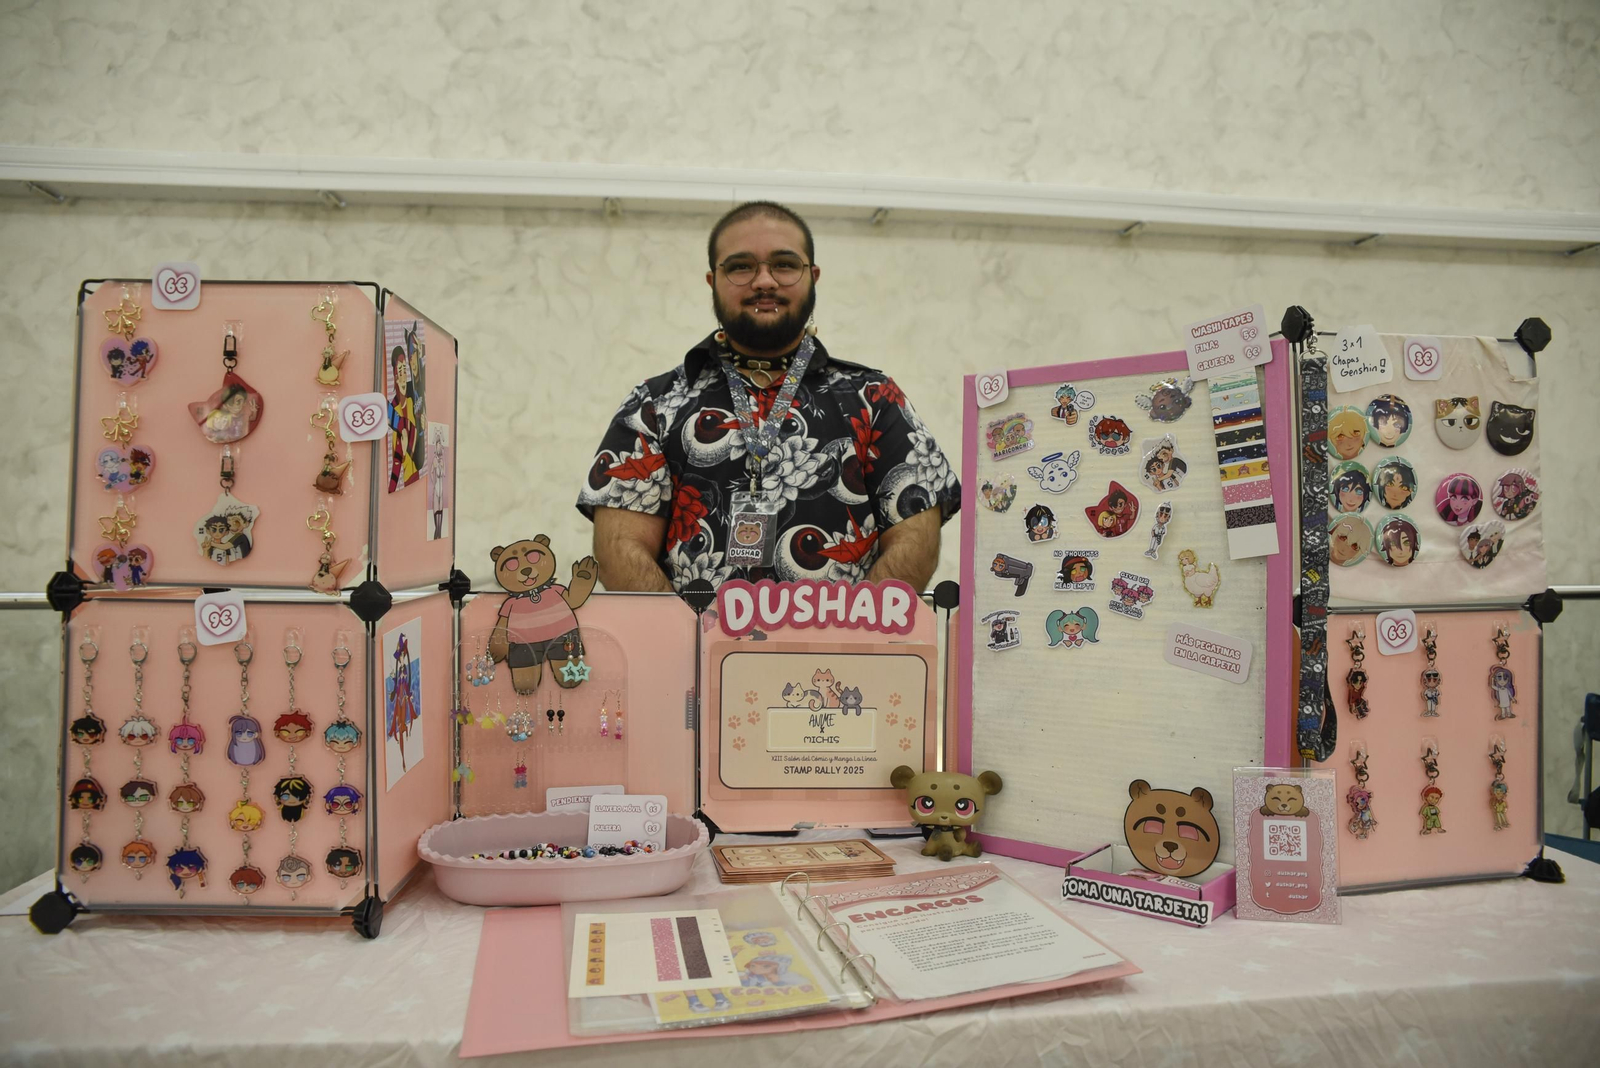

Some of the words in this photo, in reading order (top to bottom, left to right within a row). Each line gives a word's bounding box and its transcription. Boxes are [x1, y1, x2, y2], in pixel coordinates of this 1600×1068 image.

[165, 277, 188, 294] 6€
[1191, 321, 1222, 338] WASHI
[1222, 312, 1254, 330] TAPES
[1194, 340, 1219, 354] FINA:
[1242, 328, 1257, 340] 5€
[1197, 354, 1235, 371] GRUESA:
[1246, 346, 1260, 359] 6€
[1332, 355, 1359, 368] Chapas
[1414, 350, 1433, 367] 3€
[984, 378, 999, 395] 2€
[352, 409, 375, 428] 3€
[217, 553, 223, 562] 5
[730, 549, 761, 558] DUSHAR
[1064, 550, 1099, 558] THOUGHTS
[1120, 571, 1137, 582] GIVE
[1073, 582, 1095, 590] EMPTY
[724, 585, 910, 631] DUSHAR
[208, 609, 232, 629] 9€
[1387, 624, 1407, 641] 6€
[1175, 634, 1194, 647] MÁS
[1195, 639, 1241, 660] PEGATINAS
[1174, 647, 1186, 658] EN
[1187, 650, 1198, 661] LA
[1199, 654, 1241, 674] CARPETA!
[809, 713, 836, 727] ANIME
[784, 766, 812, 774] STAMP
[815, 766, 842, 774] RALLY
[843, 766, 864, 774] 2025
[551, 795, 592, 807] PENDIENT
[622, 804, 642, 813] MÓVIL
[848, 895, 984, 923] ENCARGOS
[1063, 878, 1099, 900] TOMA
[1101, 885, 1134, 907] UNA
[1134, 893, 1208, 924] TARJETA!
